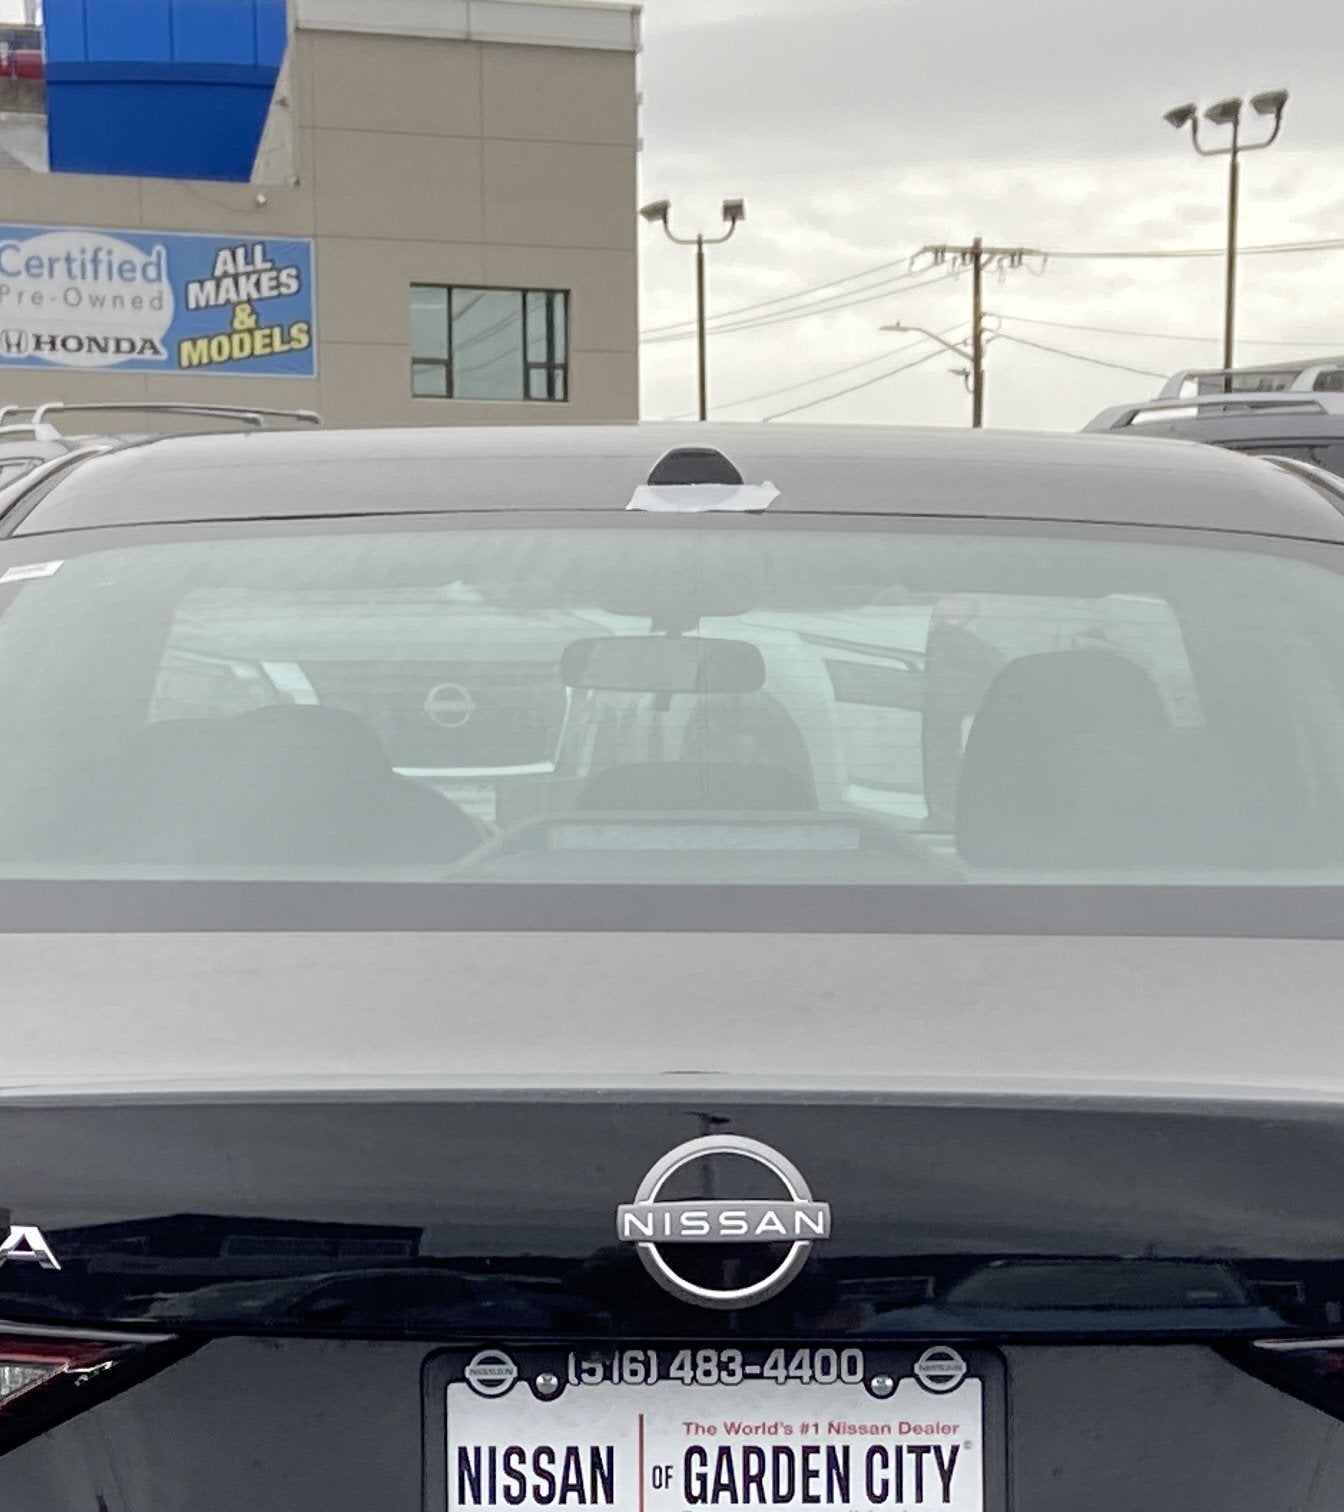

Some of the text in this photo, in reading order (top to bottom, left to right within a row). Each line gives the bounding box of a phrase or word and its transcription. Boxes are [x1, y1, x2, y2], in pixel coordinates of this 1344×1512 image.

[212, 242, 273, 277] ALL
[186, 267, 300, 310] MAKES
[232, 303, 258, 330] &
[32, 333, 163, 356] HONDA
[179, 322, 311, 368] MODELS
[623, 1210, 824, 1237] NISSAN
[568, 1348, 864, 1386] (516) 483-4400
[683, 1421, 961, 1436] The World's #1 Nissan Dealer
[458, 1444, 961, 1505] NISSAN OF GARDEN CITY
